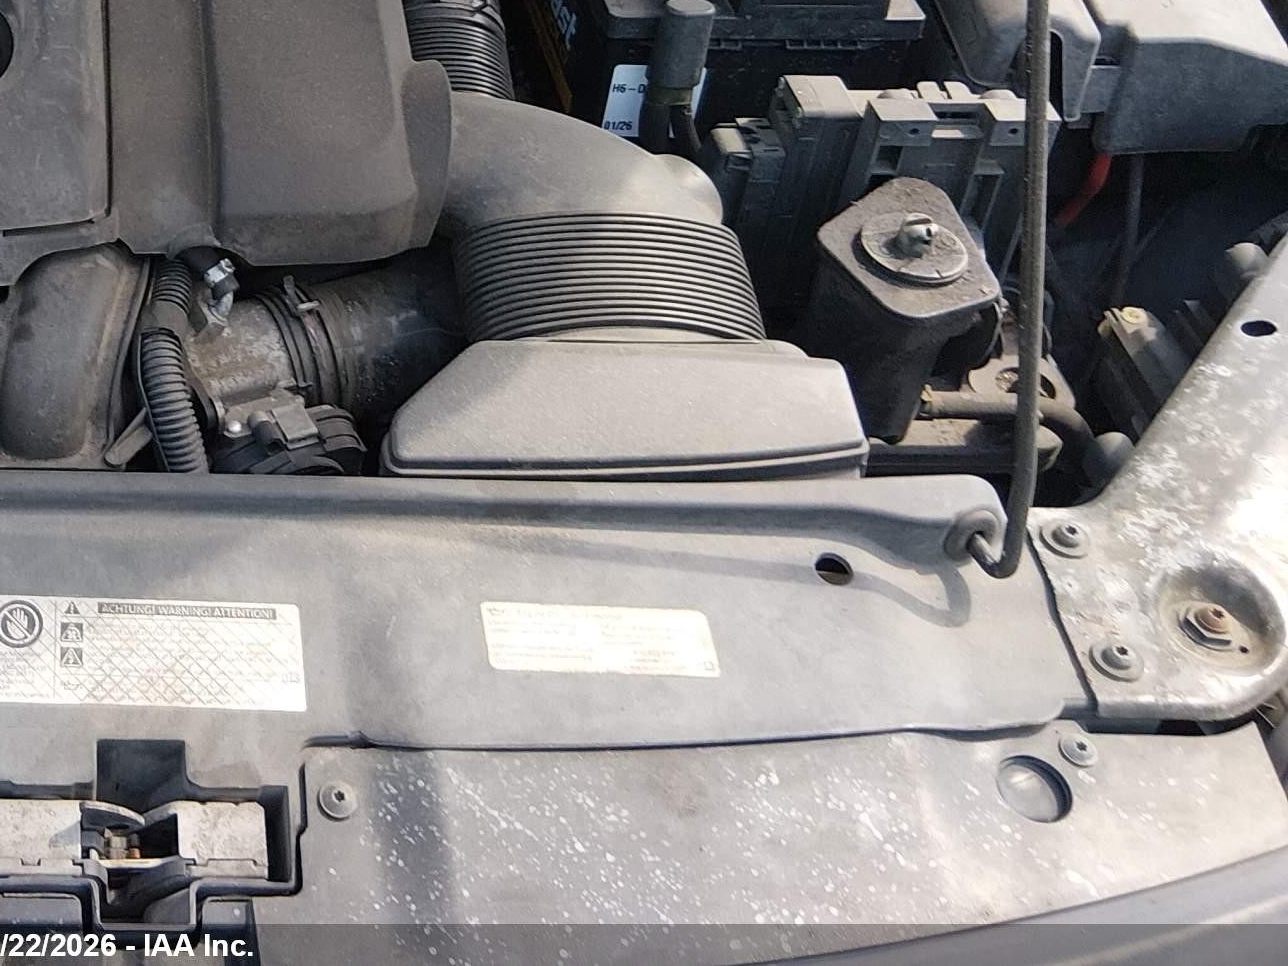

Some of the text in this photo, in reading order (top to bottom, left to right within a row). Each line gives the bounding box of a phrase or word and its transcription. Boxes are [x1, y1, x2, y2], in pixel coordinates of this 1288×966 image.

[101, 603, 274, 619] ACHTUNG! WARNING! ATTENTION!
